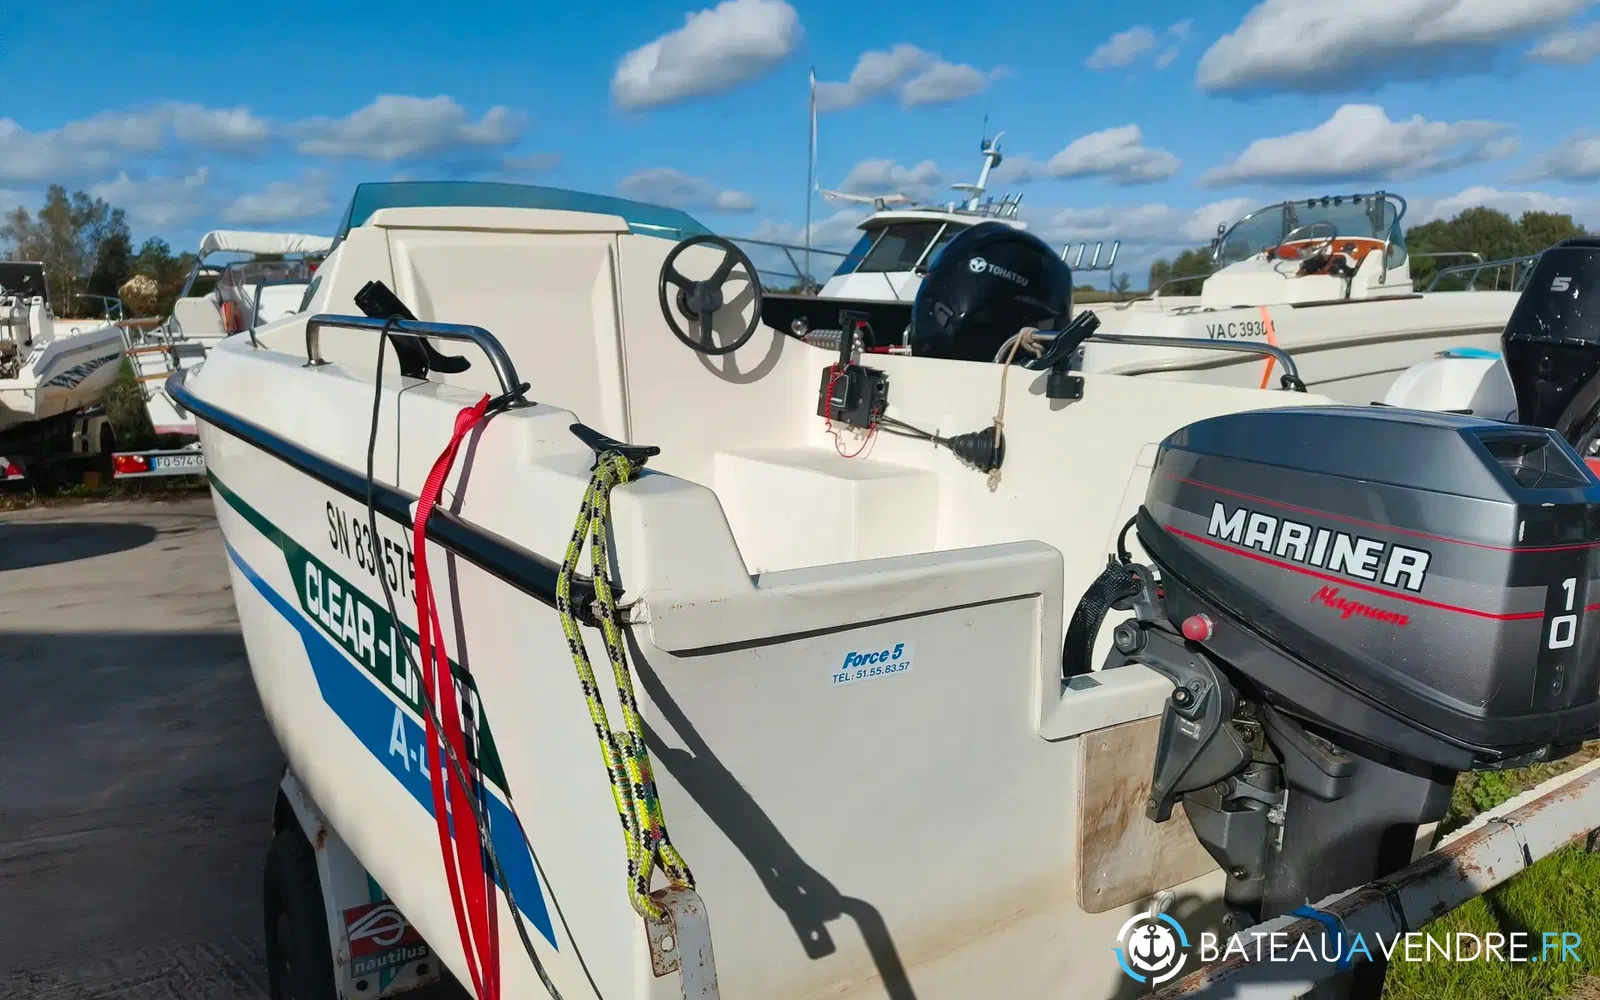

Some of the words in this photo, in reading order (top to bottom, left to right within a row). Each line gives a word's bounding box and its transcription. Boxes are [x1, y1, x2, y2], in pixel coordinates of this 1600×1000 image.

[988, 263, 1029, 287] TOHATSU
[1206, 322, 1237, 339] VAC
[326, 501, 351, 560] SN
[1207, 501, 1431, 592] MARINER
[1309, 584, 1411, 627] Magnum
[842, 650, 890, 669] Force
[892, 643, 905, 660] 5
[856, 661, 910, 679] 51.55.83.57
[355, 945, 426, 974] nautilus
